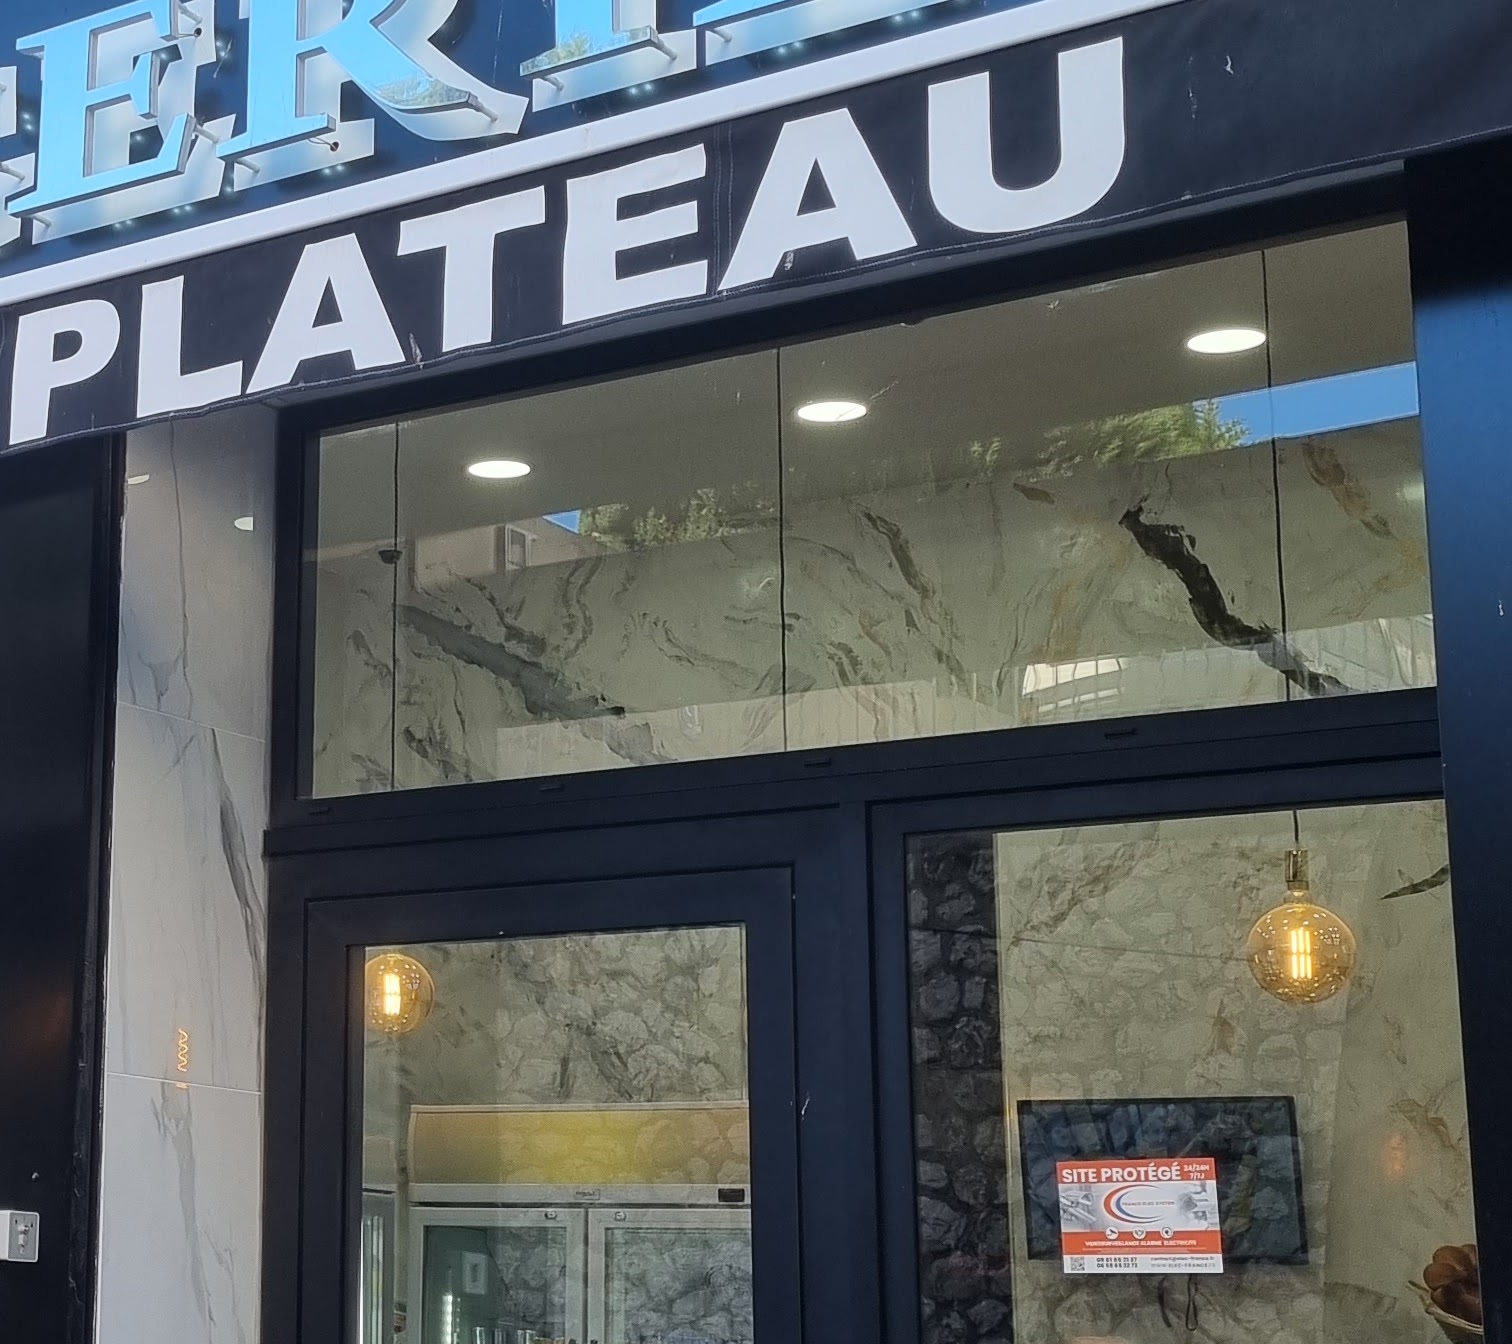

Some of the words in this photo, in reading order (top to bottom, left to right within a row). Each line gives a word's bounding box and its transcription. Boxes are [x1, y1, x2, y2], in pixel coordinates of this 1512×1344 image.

[9, 36, 1125, 445] PLATEAU
[1061, 1167, 1098, 1183] SITE
[1101, 1162, 1182, 1183] PROTÉGÉ
